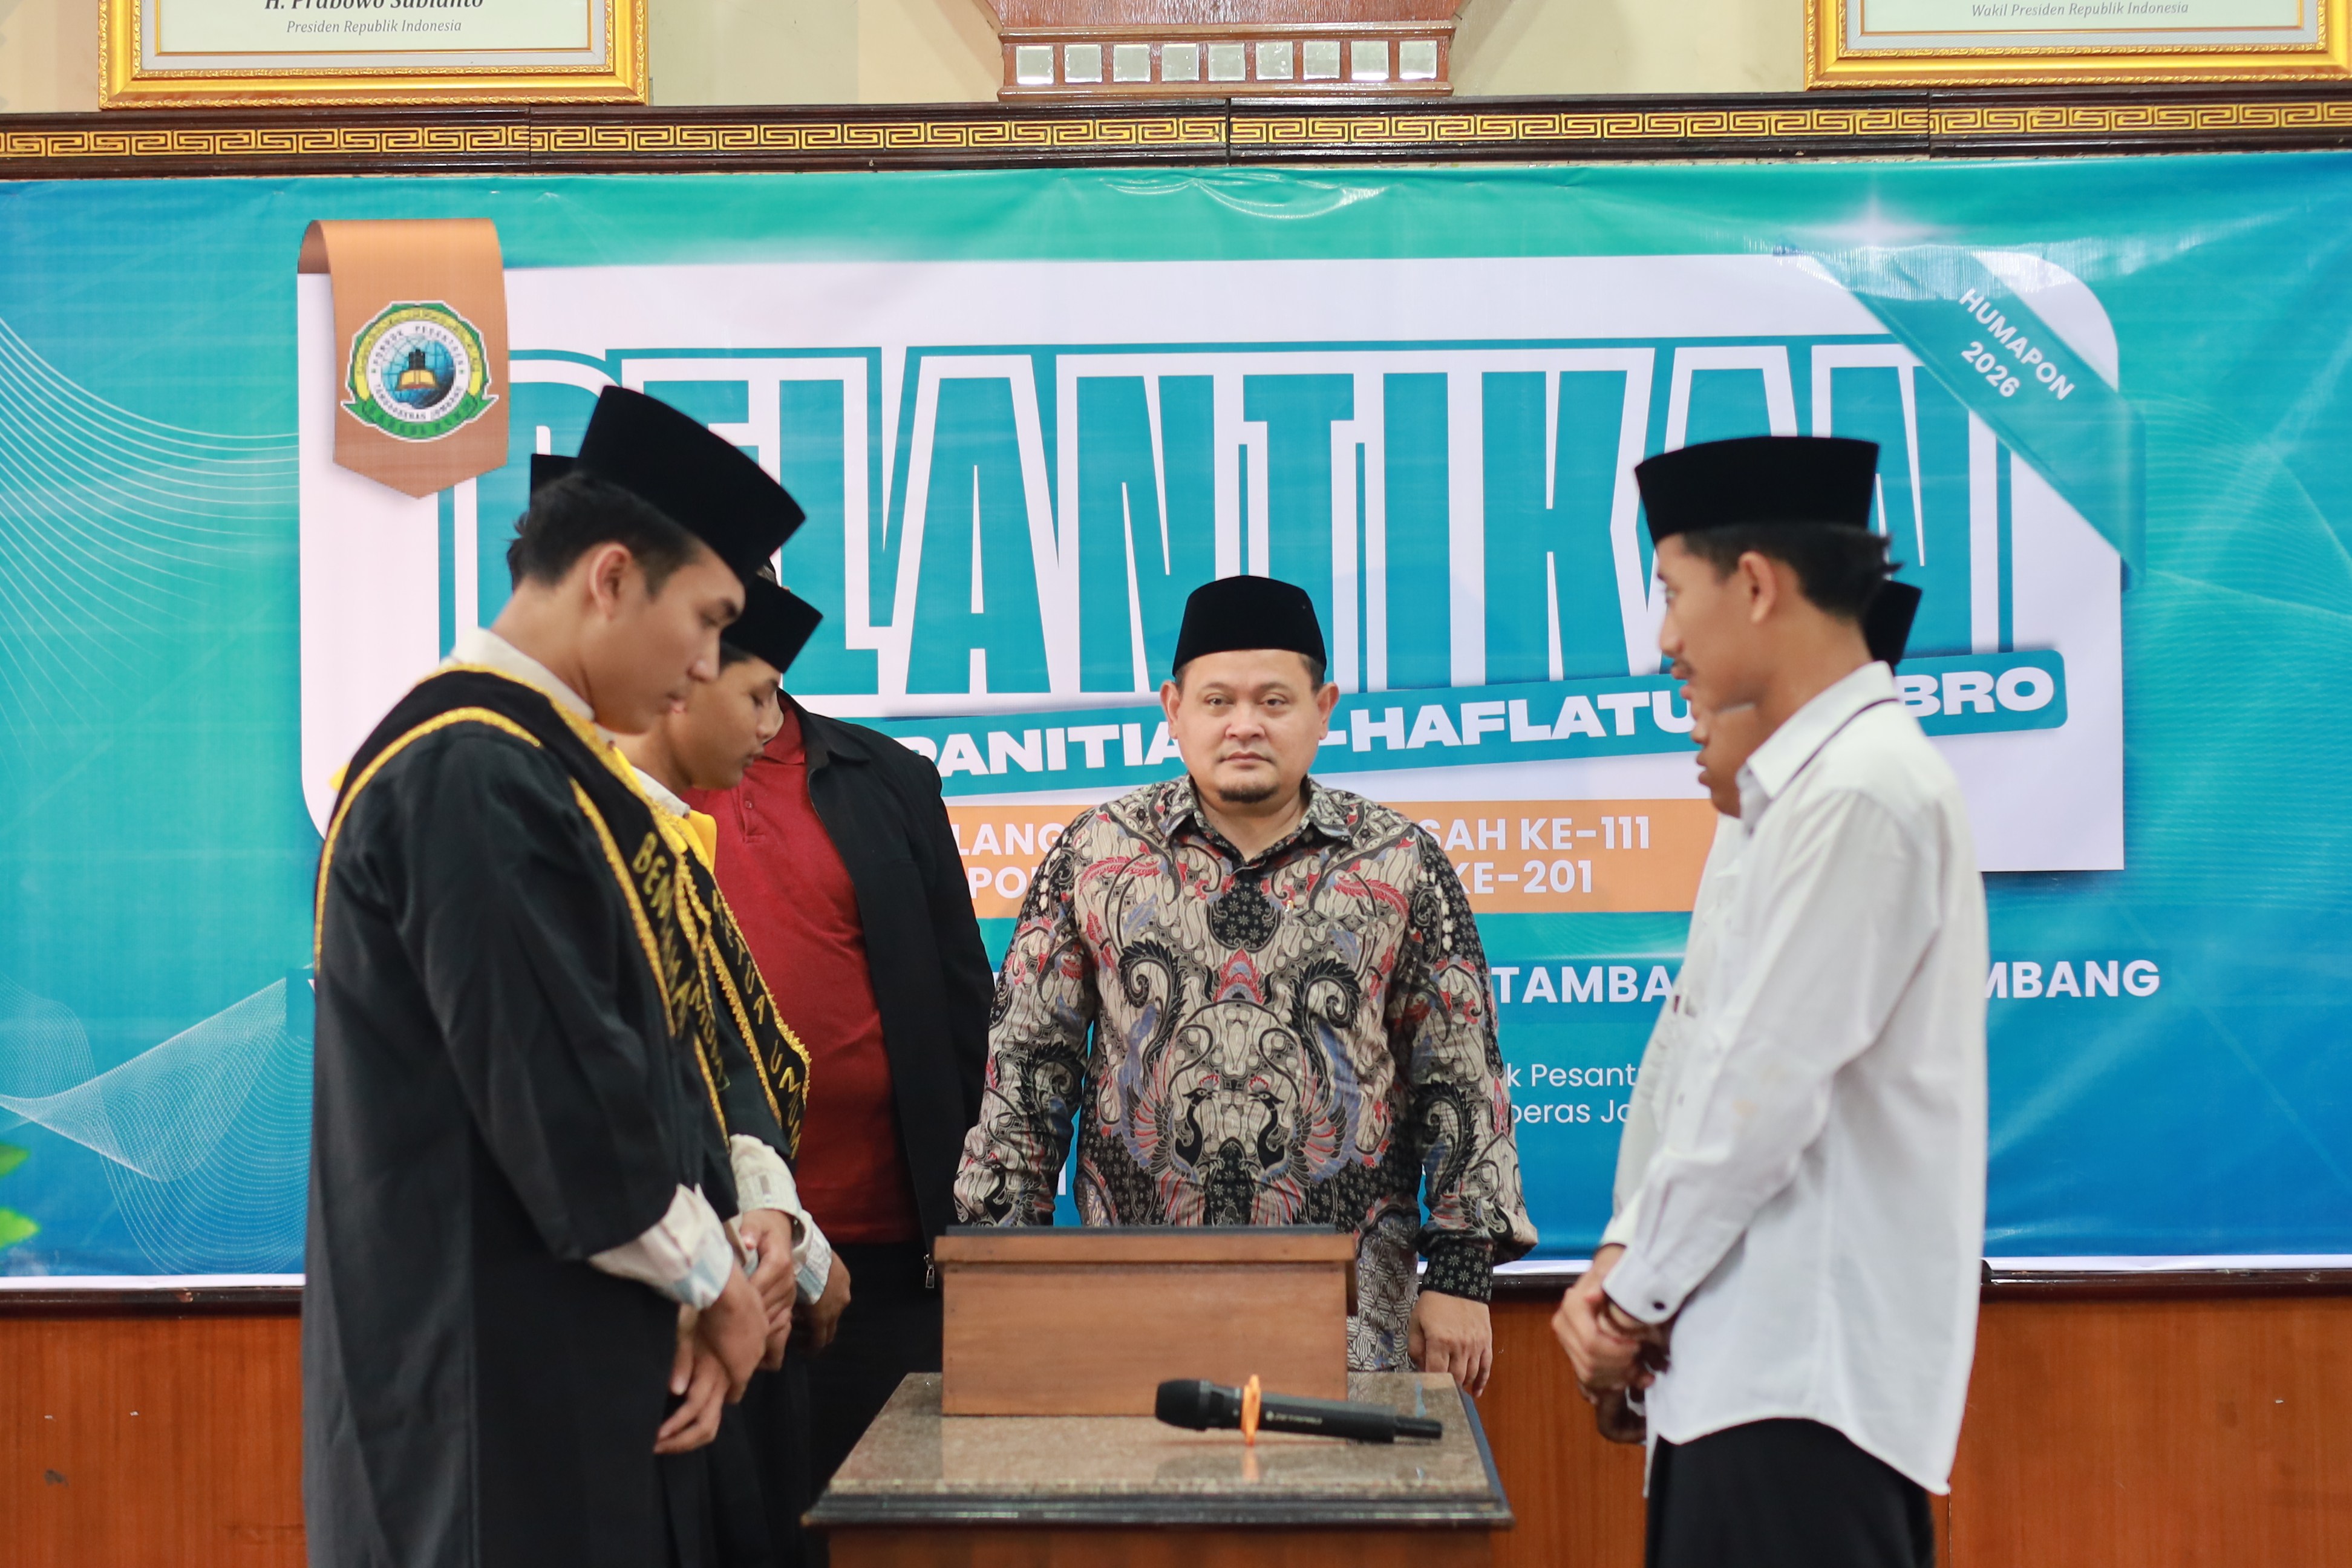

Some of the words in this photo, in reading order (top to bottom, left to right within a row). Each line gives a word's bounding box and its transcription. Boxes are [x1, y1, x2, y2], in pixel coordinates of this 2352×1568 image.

[1971, 4, 2007, 17] Wakil
[2011, 3, 2065, 16] Presiden
[2068, 2, 2124, 18] Republik
[2127, 1, 2189, 15] Indonesia
[287, 21, 340, 33] Presiden
[344, 19, 397, 36] Republik
[402, 19, 462, 32] Indonesia
[1959, 288, 2075, 401] HUMAPON
[1960, 341, 2020, 398] 2026
[1520, 816, 1650, 851] KE-111
[968, 866, 1039, 899] PO
[1531, 1063, 1642, 1087] Pesant
